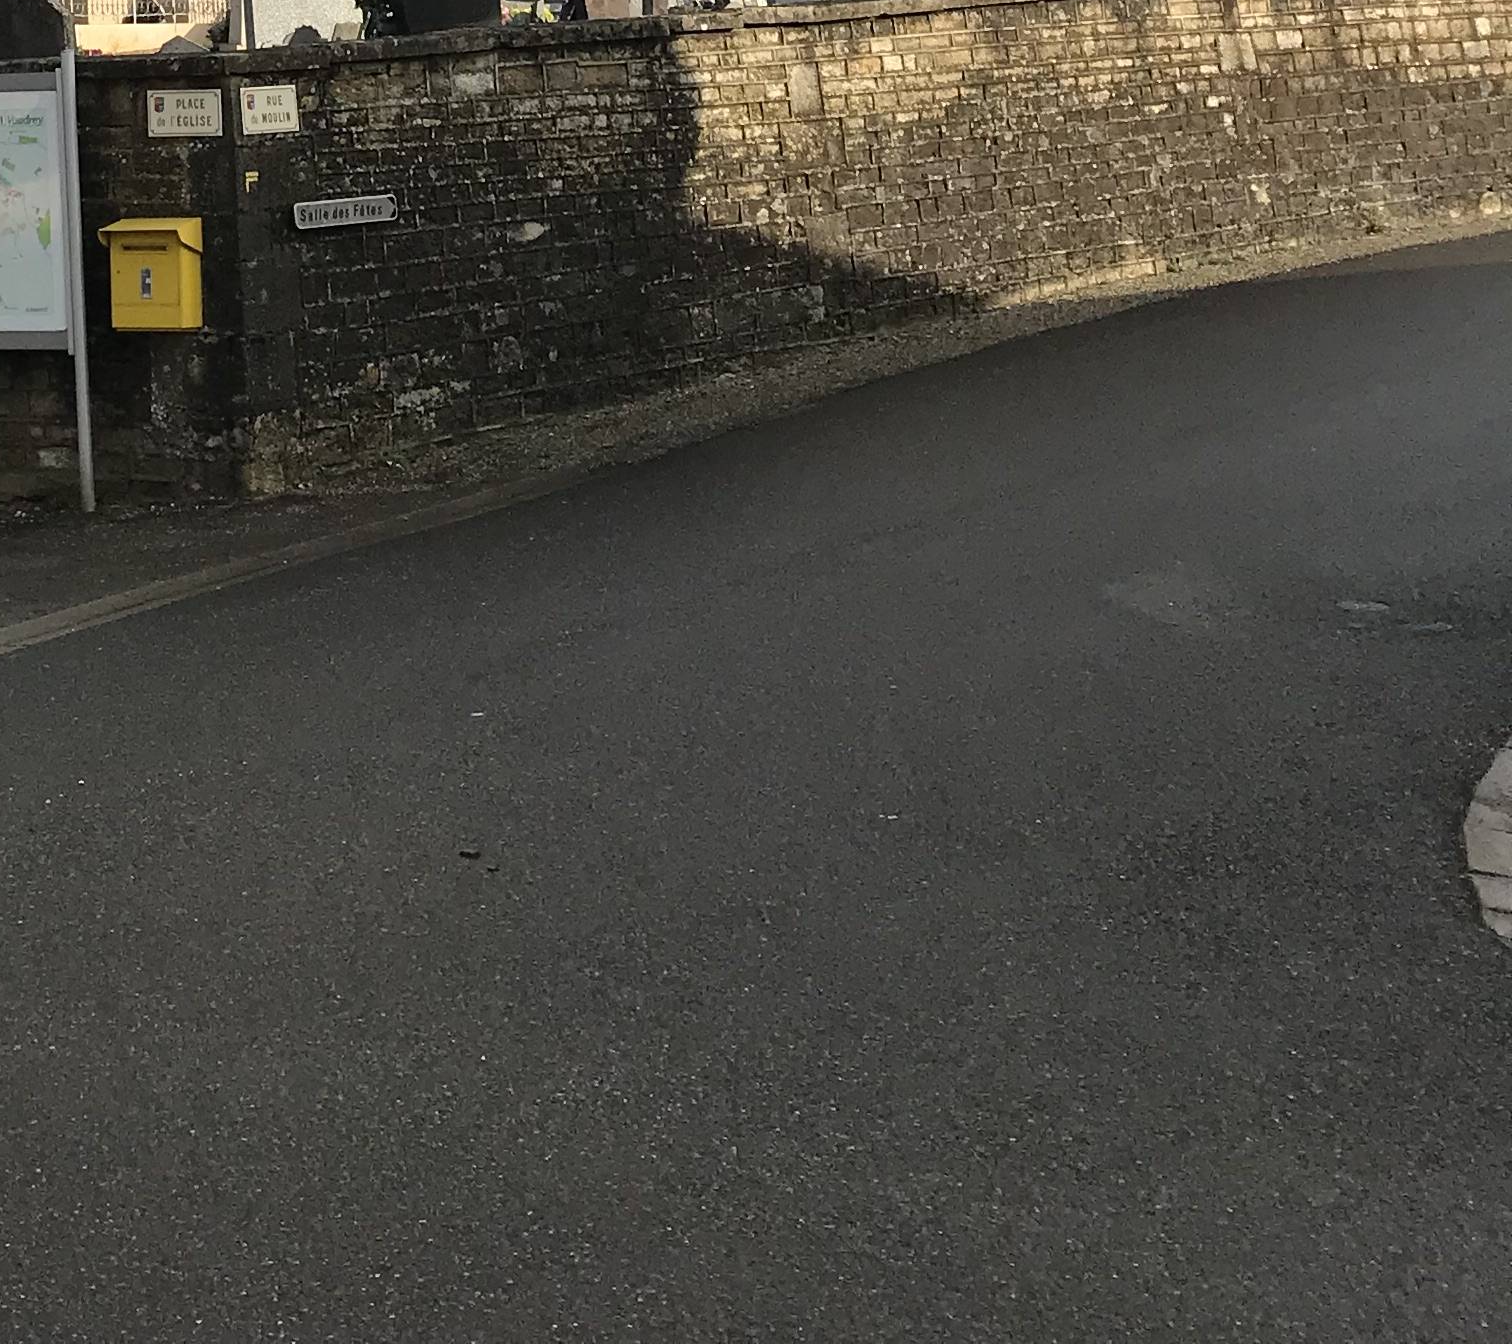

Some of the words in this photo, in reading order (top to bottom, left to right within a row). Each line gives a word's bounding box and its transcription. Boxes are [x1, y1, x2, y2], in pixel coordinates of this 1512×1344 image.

[176, 98, 206, 110] PLACE
[266, 95, 283, 106] RUE
[262, 111, 291, 124] MOULIN
[299, 208, 329, 223] Salle
[332, 206, 350, 220] des
